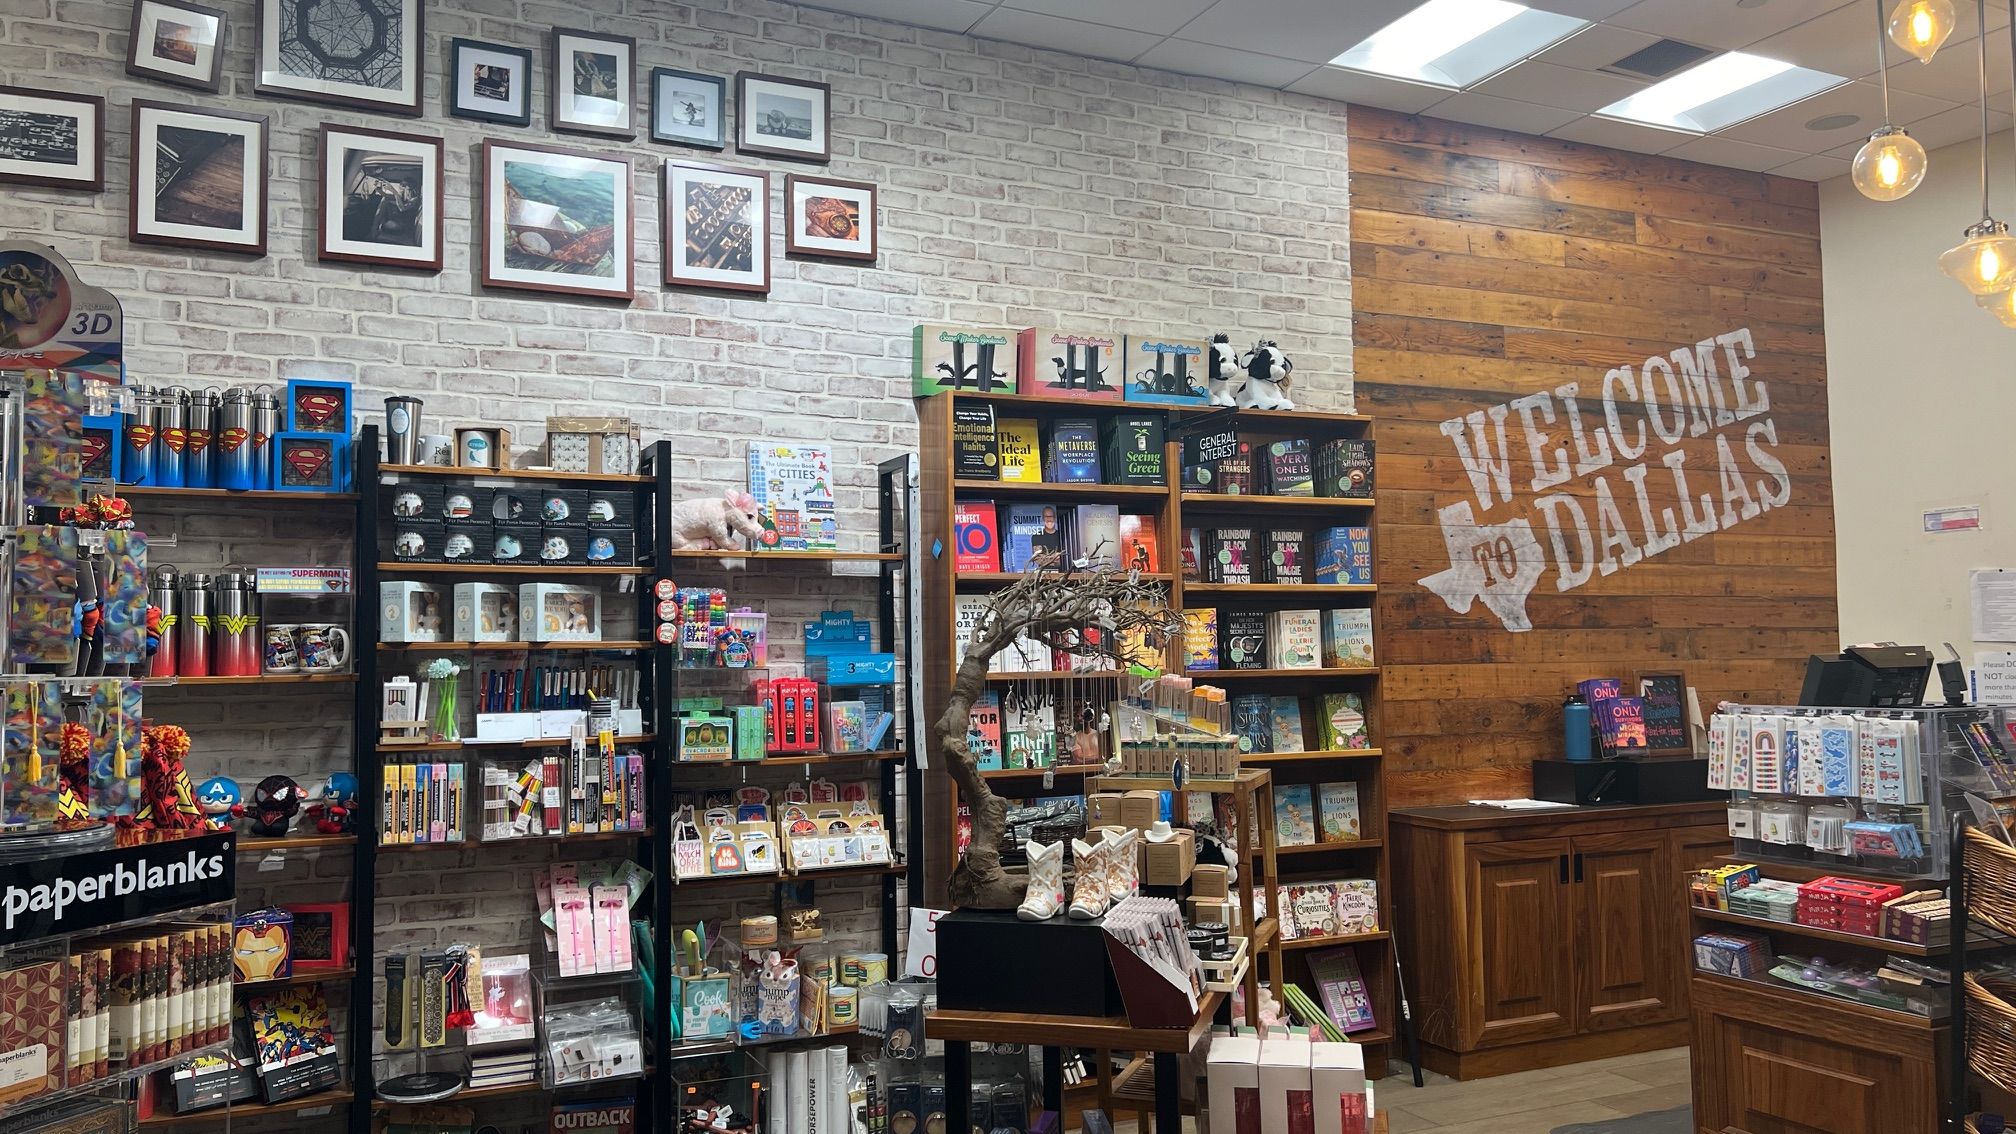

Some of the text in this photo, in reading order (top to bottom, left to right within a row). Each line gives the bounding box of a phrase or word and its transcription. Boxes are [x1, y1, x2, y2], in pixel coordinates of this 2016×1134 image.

[71, 312, 113, 336] 3D
[1439, 328, 1770, 511] WELCOME
[954, 422, 994, 433] Emotional
[998, 432, 1022, 443] The
[1199, 431, 1237, 450] GENERAL
[962, 442, 986, 451] Habits
[1001, 443, 1031, 455] Ideal
[1058, 440, 1097, 451] METAVERSE
[1126, 450, 1161, 464] Seeing
[1199, 443, 1237, 463] INTEREST
[1001, 455, 1025, 467] Life
[1274, 454, 1308, 464] EVERY
[1128, 462, 1160, 474] Green
[1219, 465, 1251, 473] STRANGERS
[1276, 465, 1310, 474] ONE IS
[779, 469, 816, 480] CITIES
[1534, 418, 1791, 592] DALLAS
[955, 513, 980, 523] PERFECT
[1014, 516, 1042, 525] SUMMIT
[1014, 526, 1045, 536] MINDSET
[1218, 529, 1251, 540] RAINBOW
[1272, 531, 1303, 542] RAINBOW
[1348, 528, 1369, 541] NOW
[955, 523, 992, 555] 10
[1223, 541, 1247, 551] BLACK
[1277, 542, 1300, 552] BLACK
[1352, 541, 1369, 553] YOU
[1353, 554, 1370, 567] SEE
[1472, 535, 1517, 588] TO
[292, 570, 340, 578] SUPERMAN
[1223, 564, 1250, 575] MAGGIE
[1276, 566, 1302, 576] MAGGIE
[1358, 567, 1371, 580] US
[1223, 575, 1251, 584] THRASH
[1276, 576, 1303, 584] THRASH
[1285, 618, 1317, 626] FUNERAL
[847, 662, 856, 674] 3
[1594, 688, 1619, 698] ONLY
[1613, 706, 1640, 717] ONLY
[1325, 797, 1355, 805] TRIUMPH
[1332, 812, 1352, 820] LIONS
[2, 850, 224, 930] paperblanks
[1344, 894, 1362, 902] FAERIE
[1343, 902, 1366, 911] KINGDOM
[694, 990, 724, 1006] Cook
[554, 1108, 631, 1129] OUTBACK
